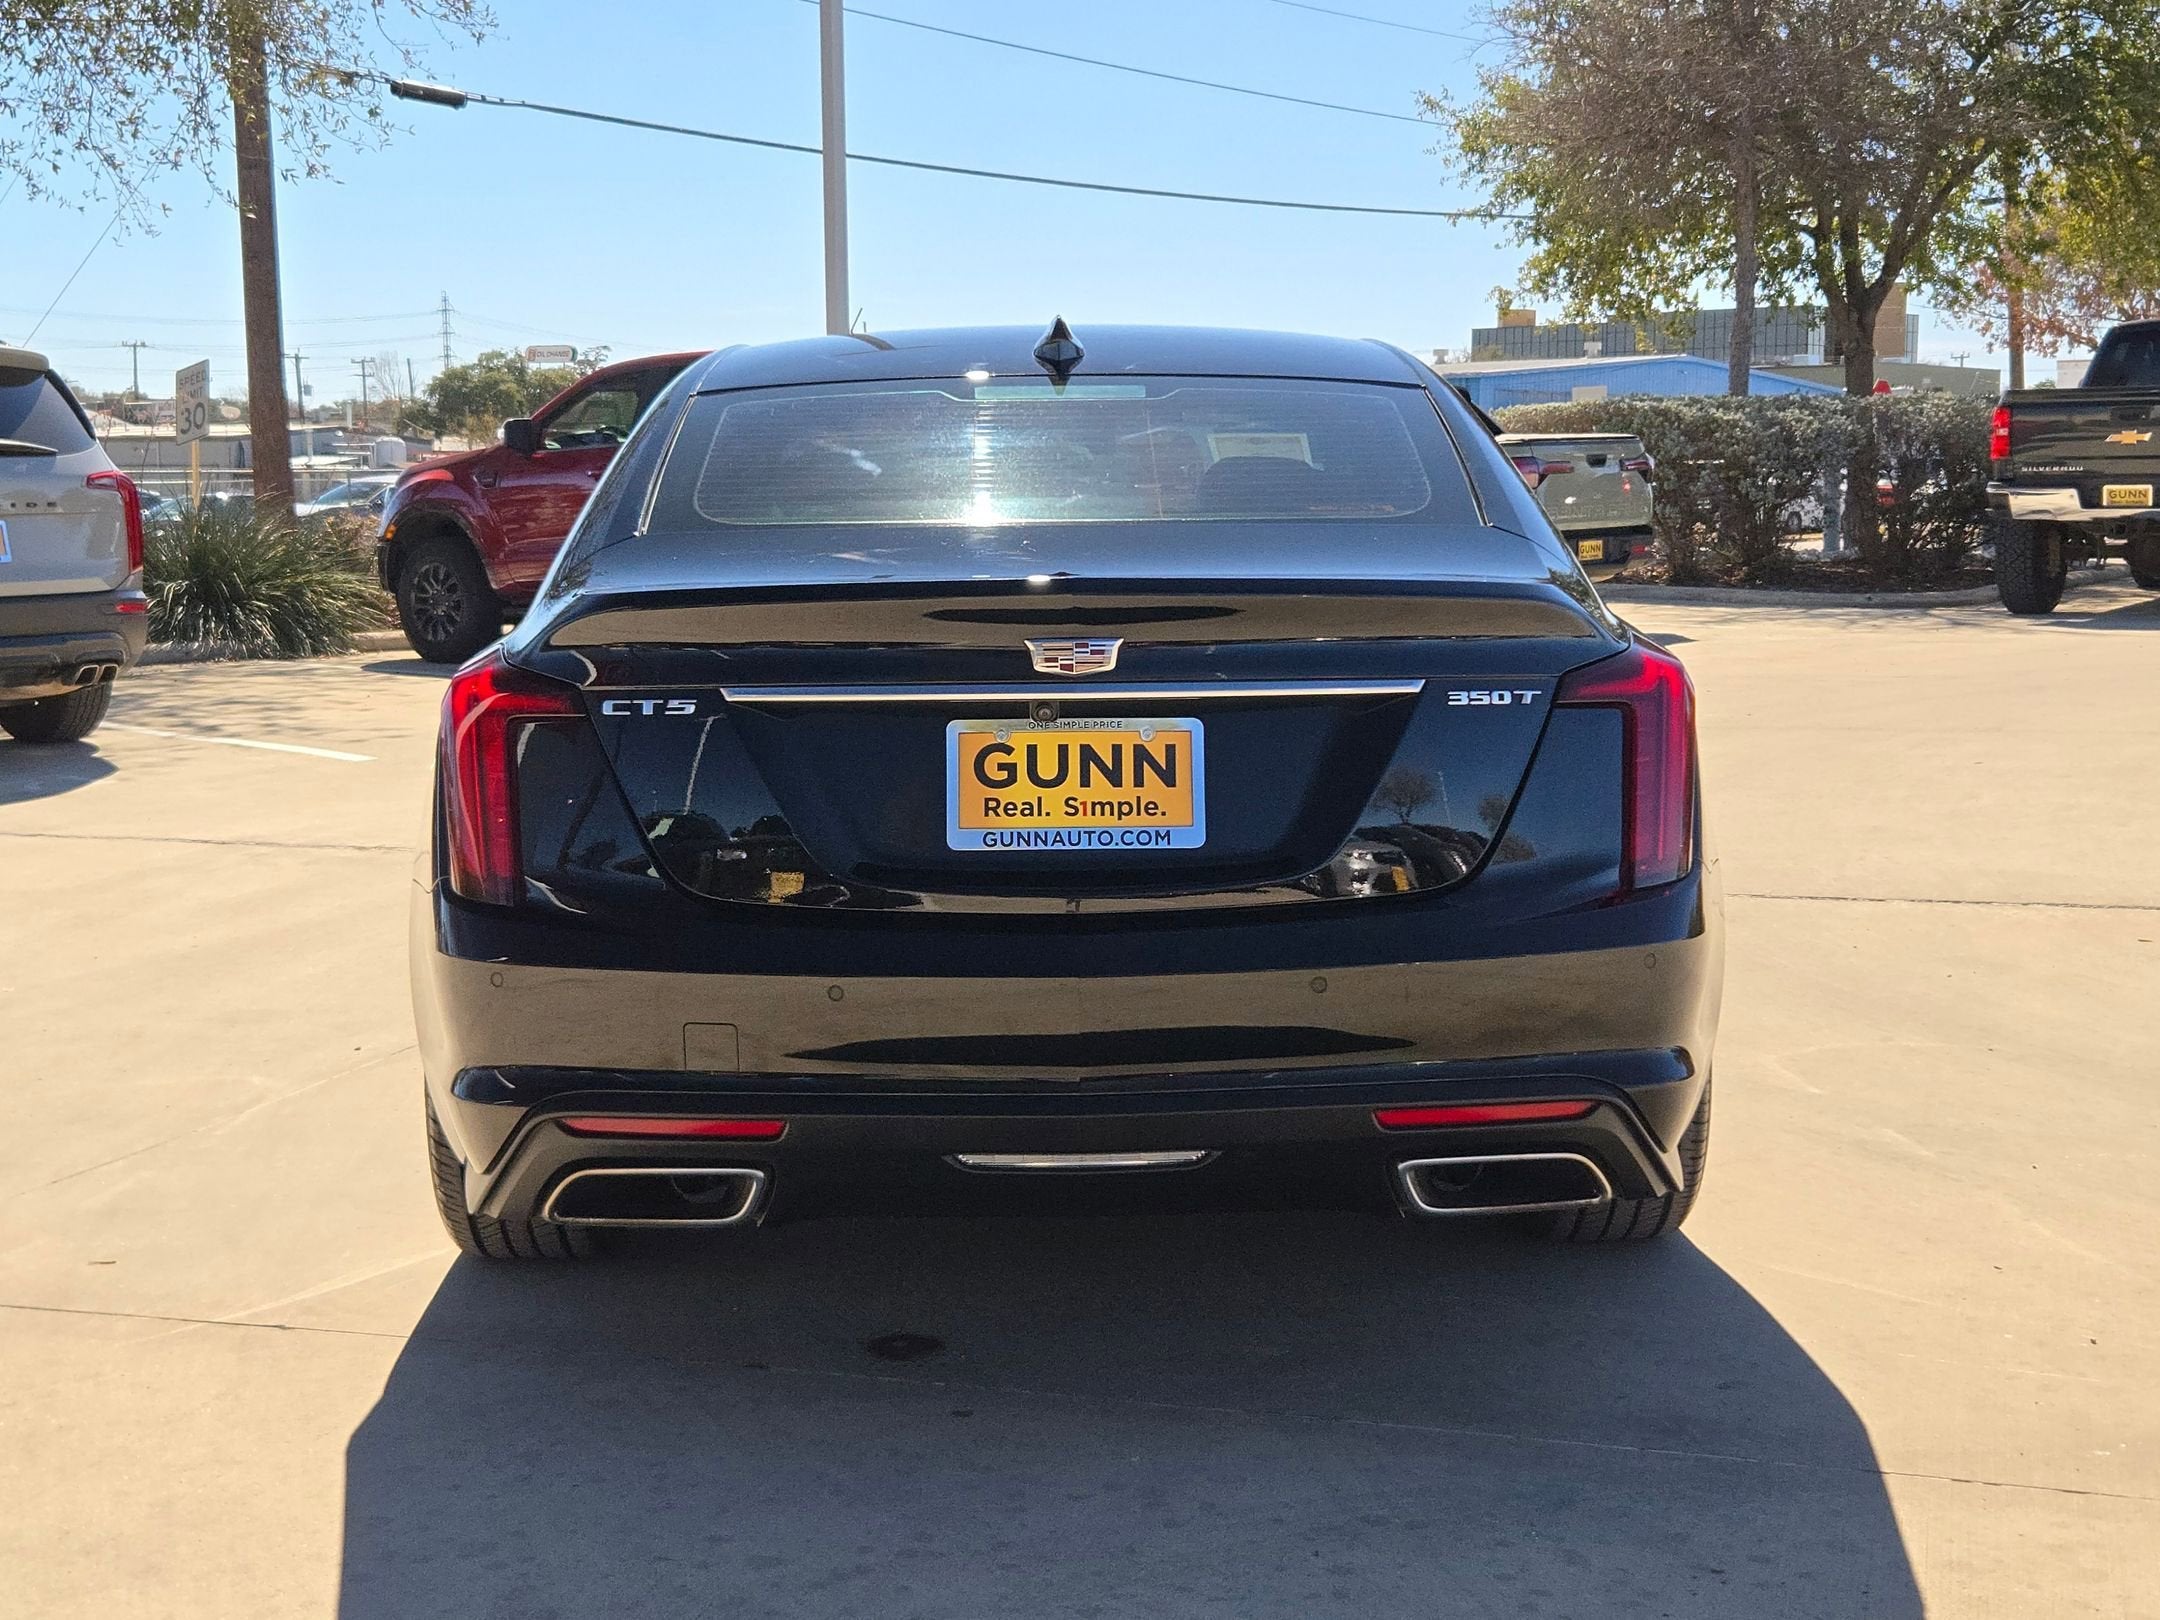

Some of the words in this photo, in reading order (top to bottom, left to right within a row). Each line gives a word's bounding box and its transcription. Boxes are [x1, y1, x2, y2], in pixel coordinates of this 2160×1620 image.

[179, 370, 207, 391] SPEED
[180, 401, 206, 435] 30
[2108, 490, 2147, 499] GUNN
[1580, 543, 1601, 554] GUNN
[1447, 690, 1542, 705] 350T
[602, 699, 697, 715] CT5
[1028, 721, 1050, 729] ONE
[1053, 721, 1090, 729] SIMPLE
[1093, 720, 1123, 729] PRICE
[973, 742, 1177, 789] GUNN
[983, 796, 1051, 818] Real.
[982, 830, 1171, 848] GUNNAUTO.COM
